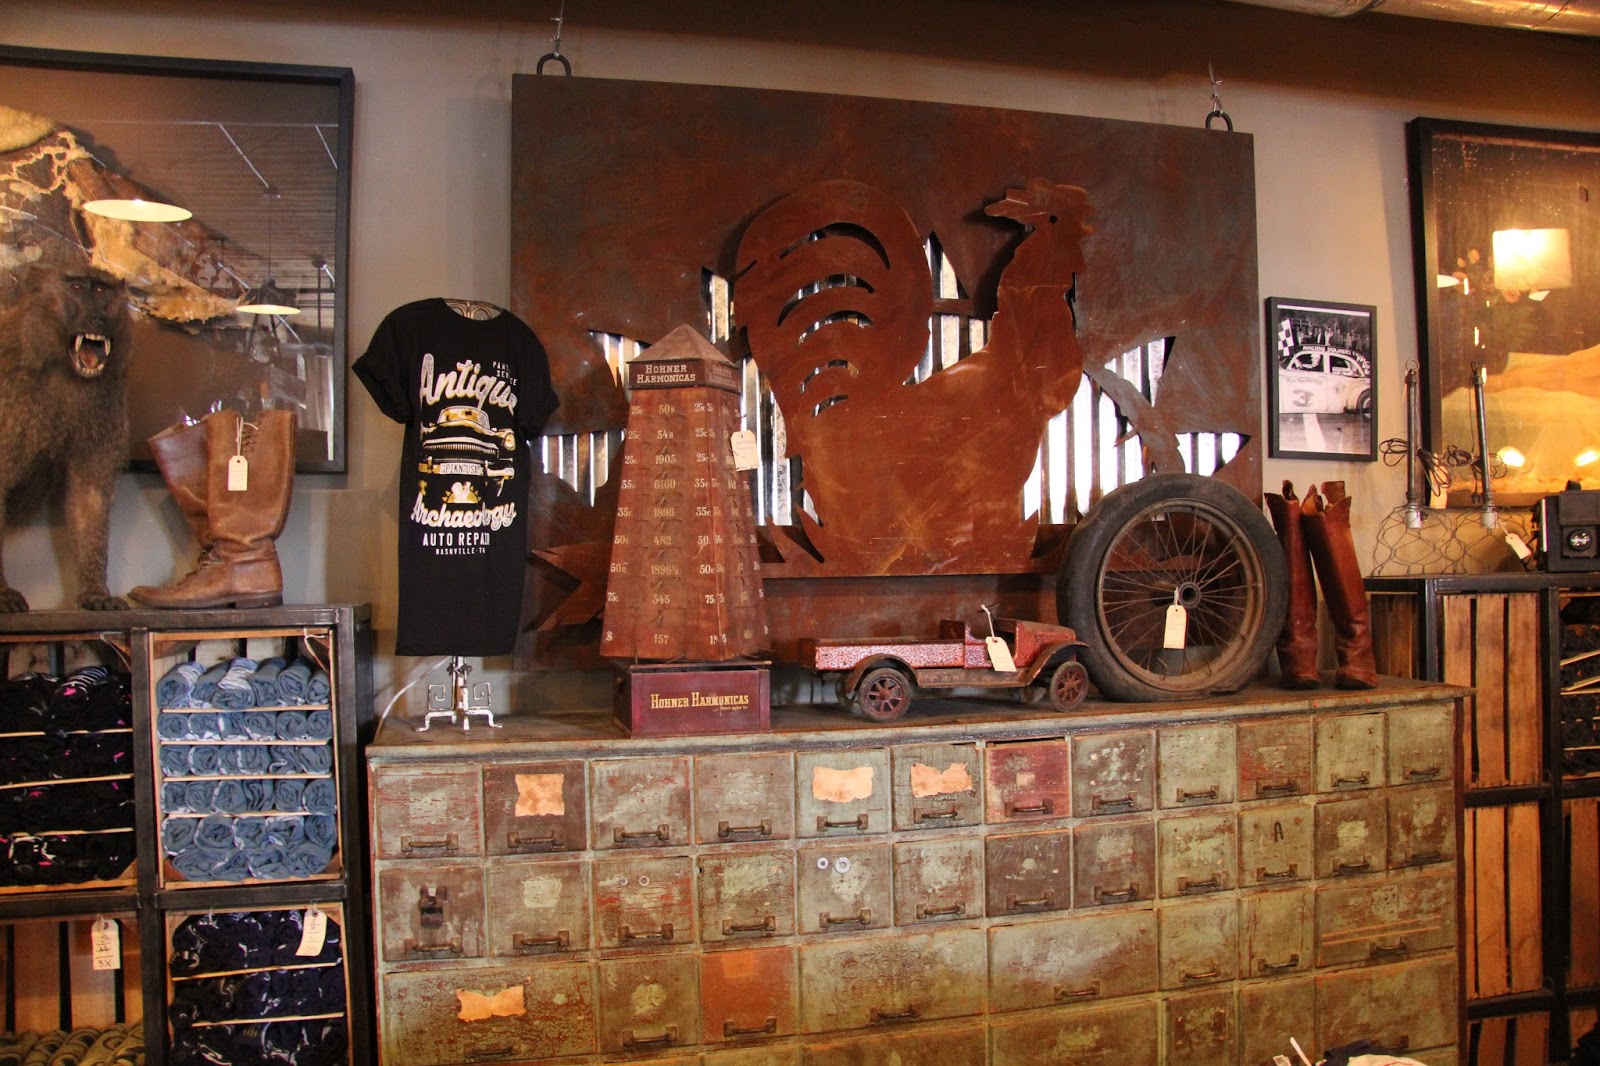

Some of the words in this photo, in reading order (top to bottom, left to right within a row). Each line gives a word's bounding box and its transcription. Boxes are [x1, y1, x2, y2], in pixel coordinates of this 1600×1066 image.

[645, 364, 688, 374] HOHNER
[636, 373, 696, 384] HARMONICAS
[419, 352, 518, 417] Antique
[655, 454, 676, 465] 1905
[410, 492, 517, 531] Archaeology
[654, 507, 675, 517] 1896
[423, 533, 453, 546] AUTO
[459, 533, 490, 546] REPAIR
[653, 535, 672, 545] 482
[650, 693, 690, 709] HOHNER
[691, 691, 749, 707] HARMONICAS
